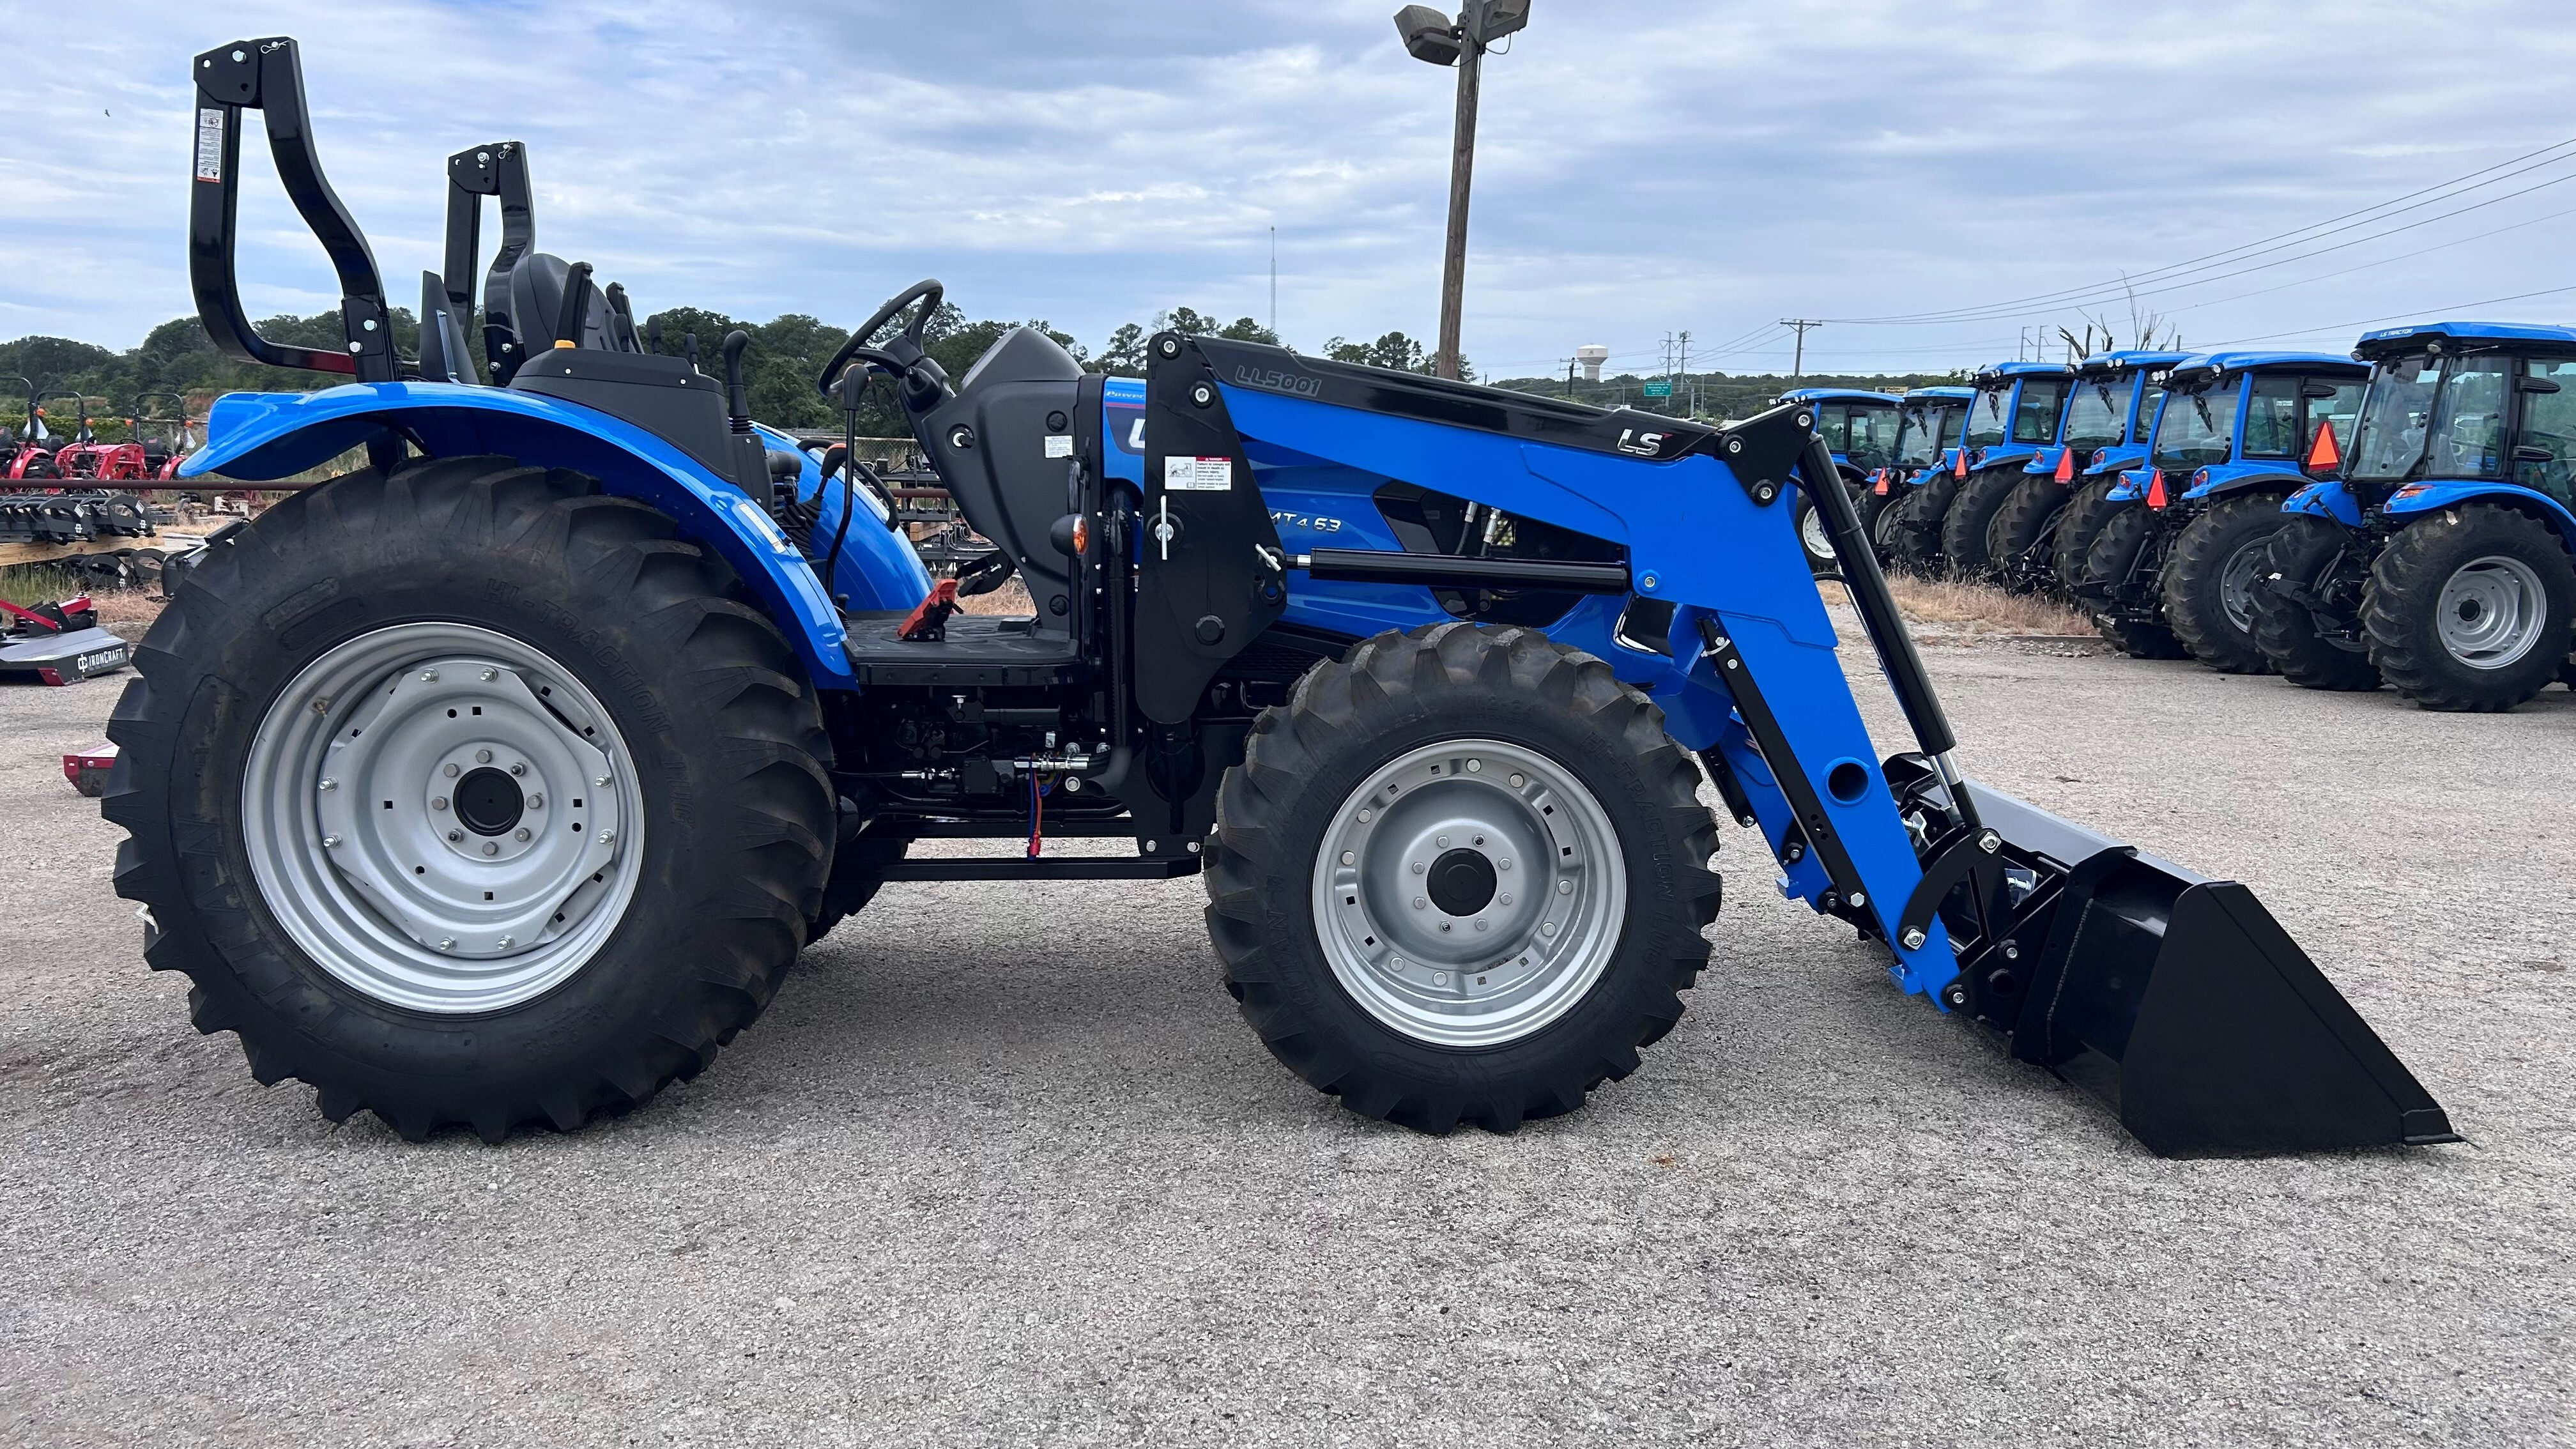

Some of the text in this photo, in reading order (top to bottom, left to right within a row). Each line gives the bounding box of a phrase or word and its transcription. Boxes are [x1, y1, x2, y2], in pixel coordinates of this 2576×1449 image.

[1234, 365, 1322, 397] LL5001
[1617, 428, 1663, 456] LS
[1314, 518, 1342, 532] 63
[174, 816, 356, 1050] TITAN
